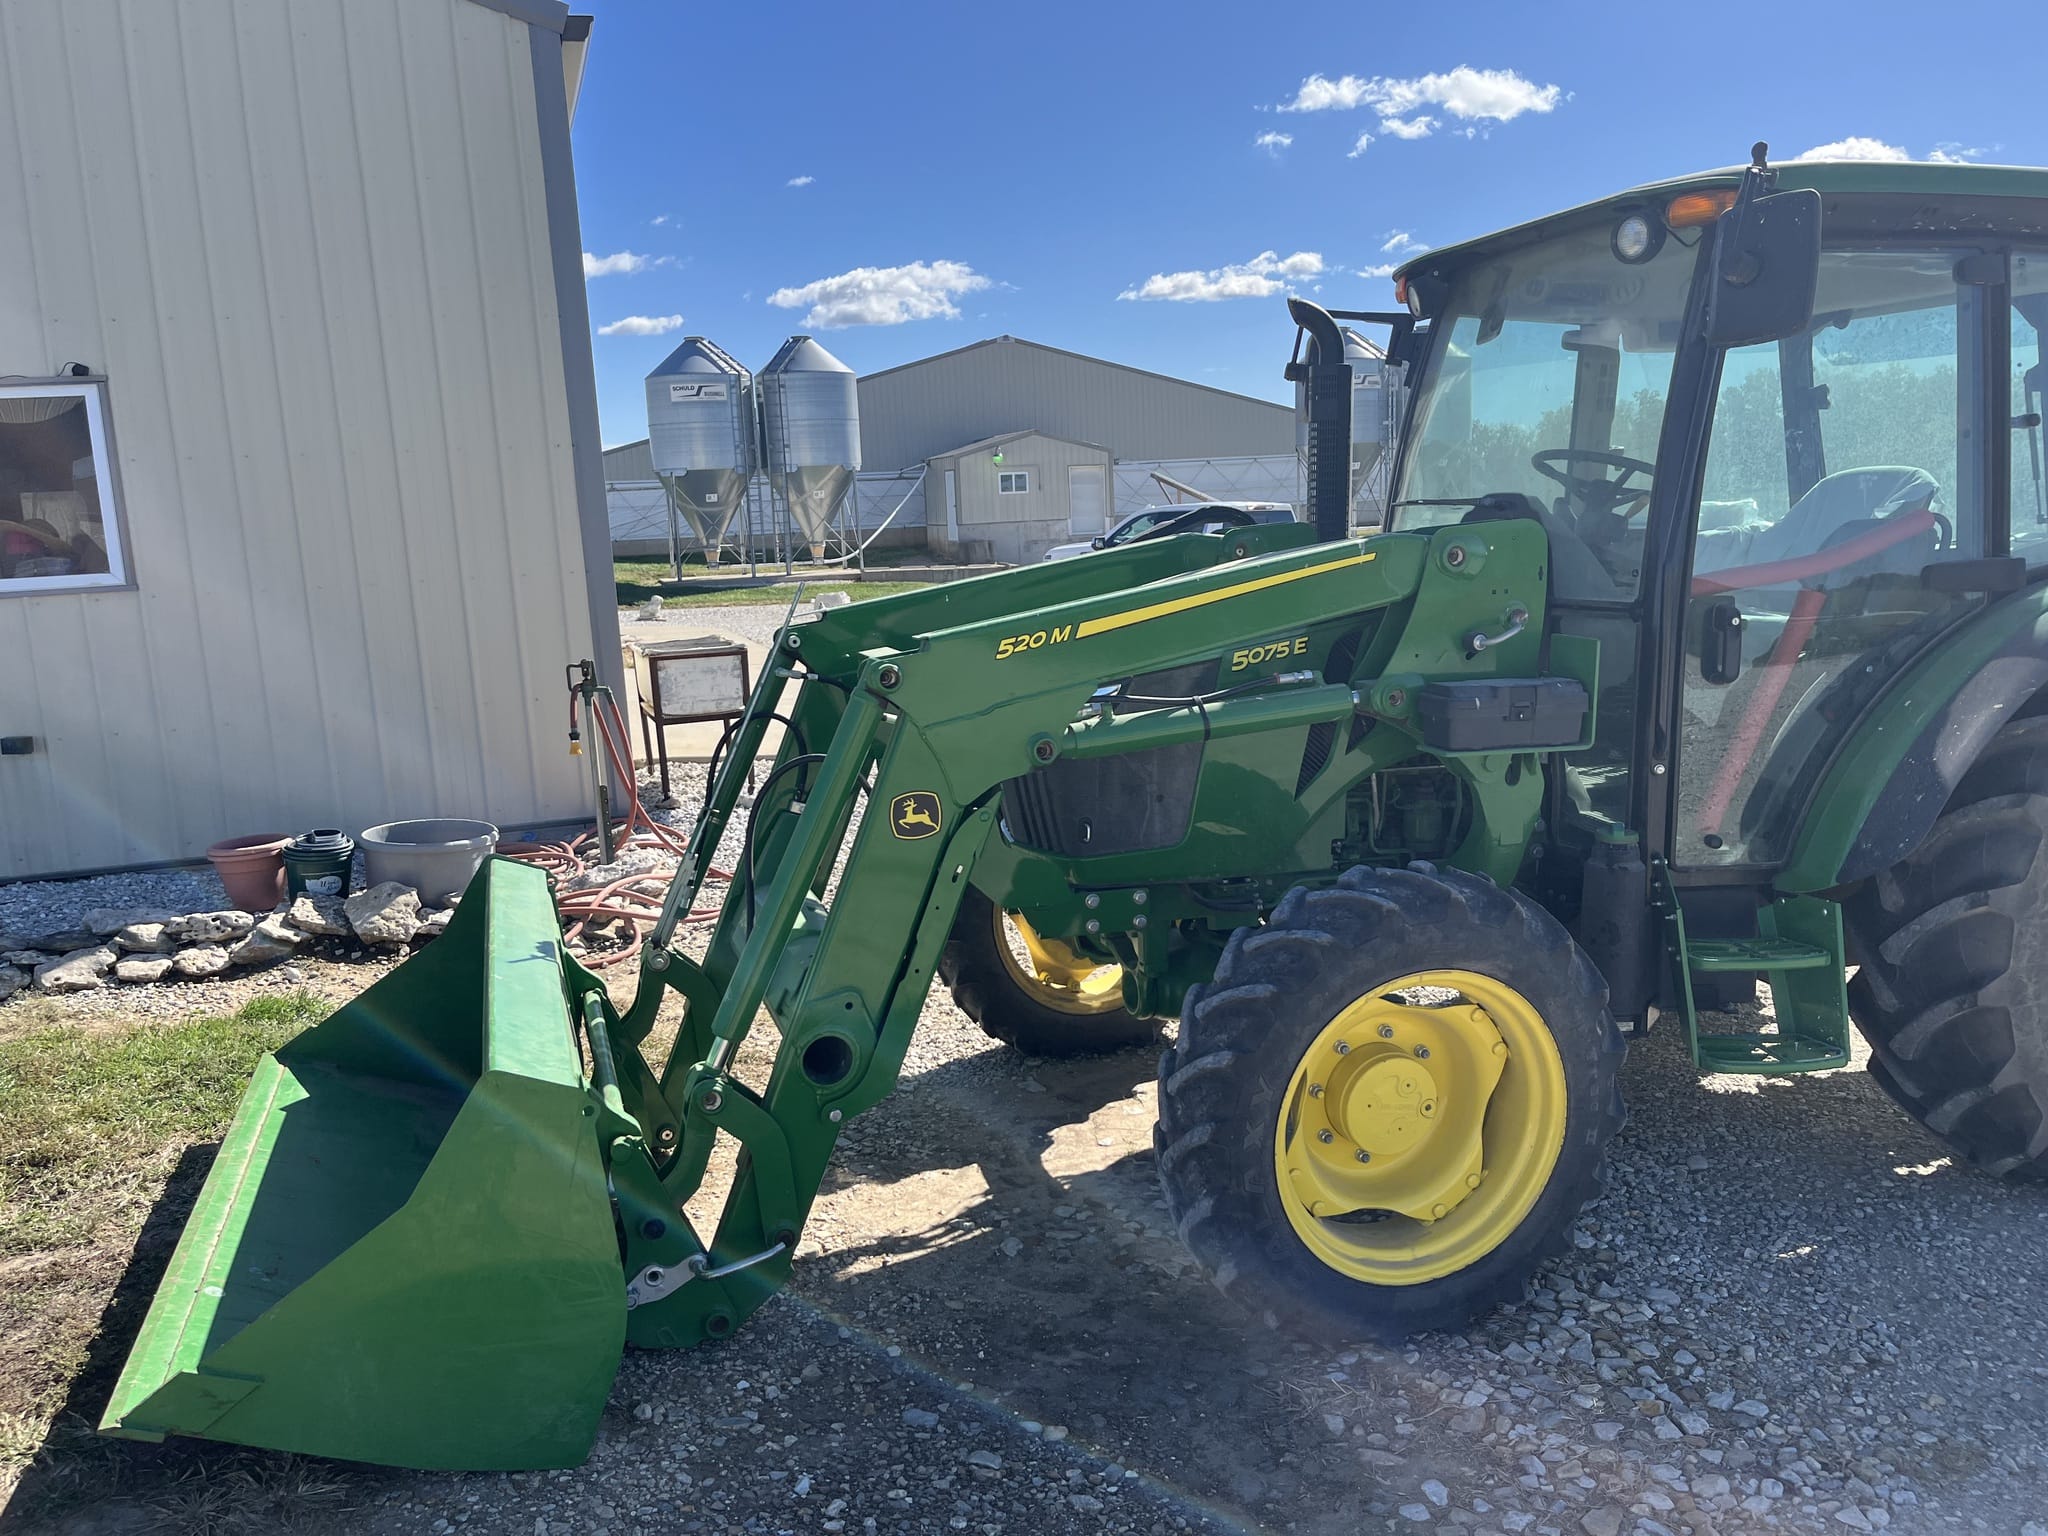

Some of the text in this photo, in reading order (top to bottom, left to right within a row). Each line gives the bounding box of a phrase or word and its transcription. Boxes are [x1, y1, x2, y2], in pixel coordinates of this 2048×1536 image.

[995, 624, 1073, 660] 520 M
[1231, 636, 1310, 672] 5075 E
